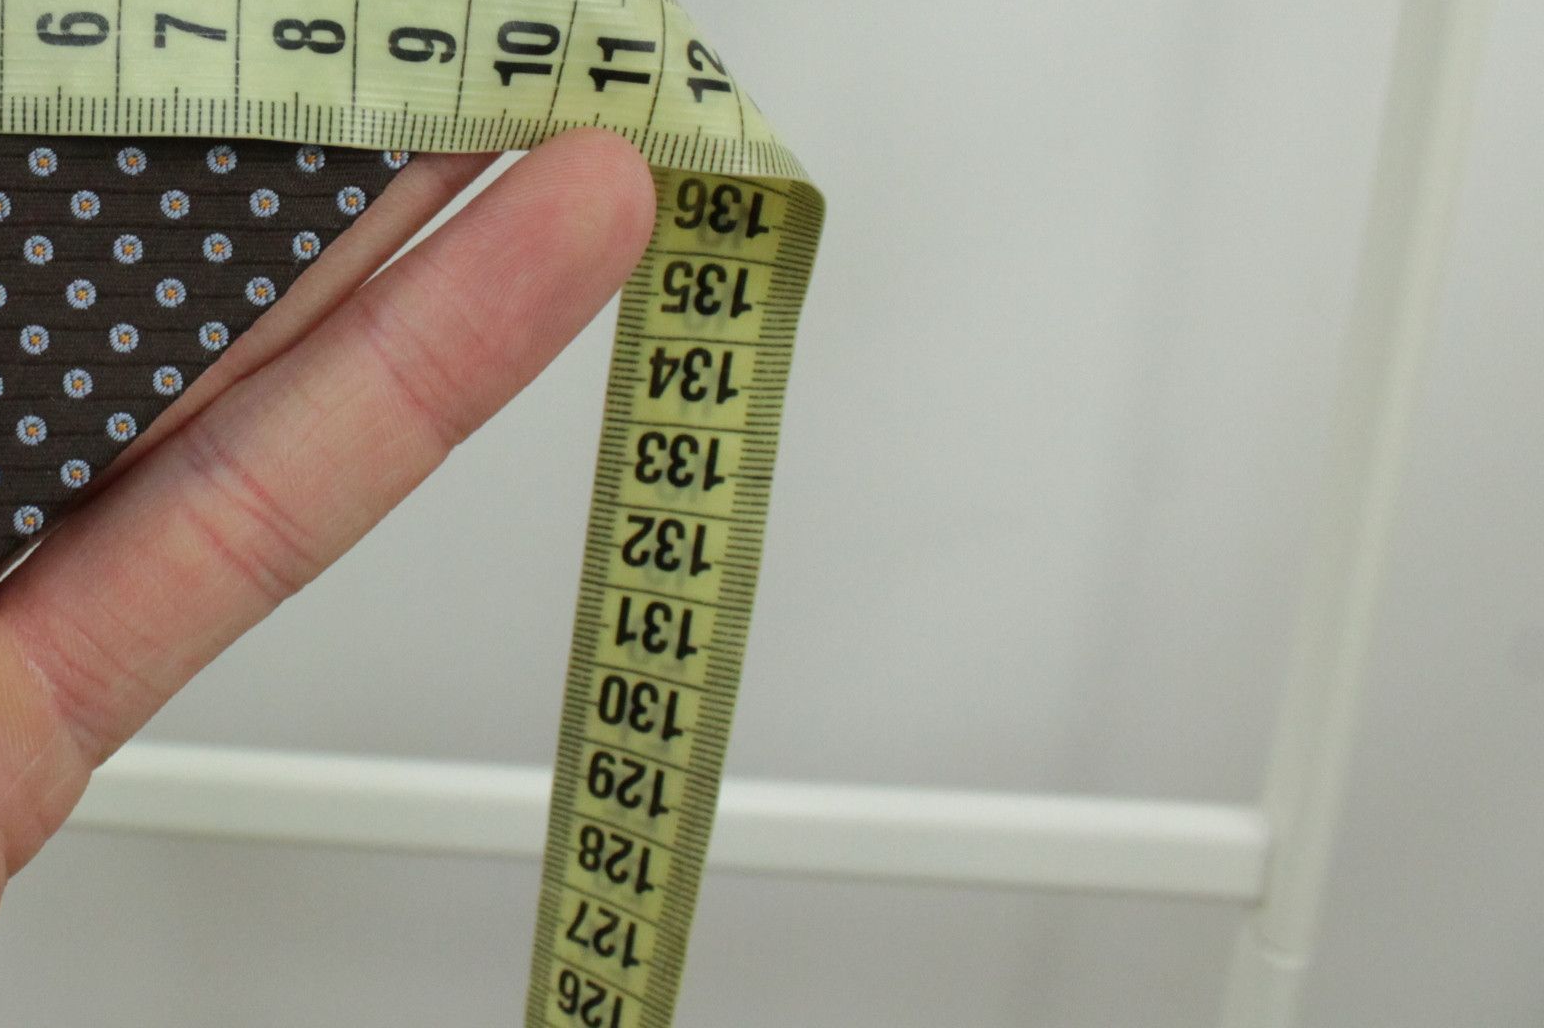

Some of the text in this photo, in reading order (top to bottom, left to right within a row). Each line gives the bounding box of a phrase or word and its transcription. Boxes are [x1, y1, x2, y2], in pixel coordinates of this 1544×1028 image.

[36, 10, 110, 47] 6
[154, 12, 227, 48] 7
[272, 18, 346, 55] 8
[388, 26, 456, 64] 9
[493, 20, 561, 87] 10
[587, 36, 656, 93] 11
[686, 38, 732, 103] 12
[674, 177, 770, 239] 136
[660, 261, 753, 319] 135
[648, 347, 739, 405] 134
[634, 431, 725, 492] 133
[621, 514, 712, 577] 132
[614, 596, 698, 661] 131
[598, 674, 683, 742] 130
[587, 751, 669, 819] 129
[578, 824, 654, 894] 128
[565, 901, 640, 969] 127
[558, 969, 623, 1028] 126
